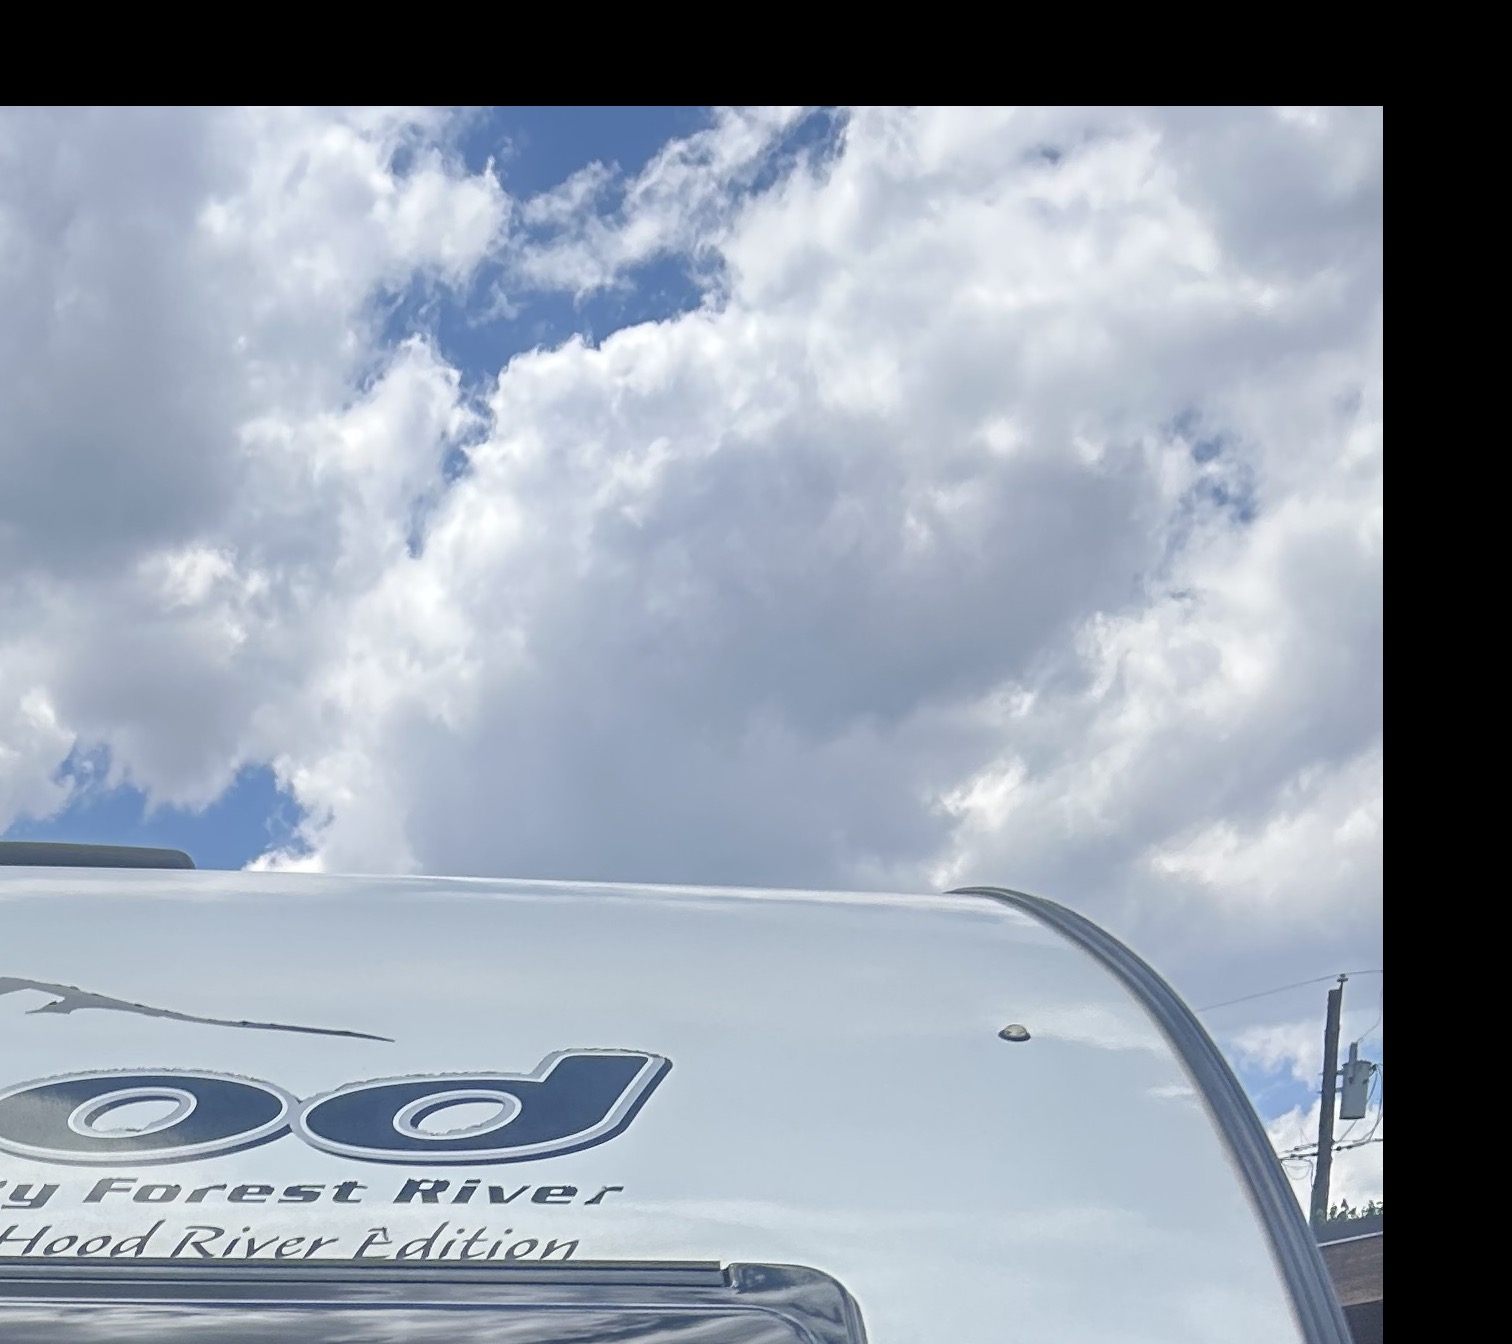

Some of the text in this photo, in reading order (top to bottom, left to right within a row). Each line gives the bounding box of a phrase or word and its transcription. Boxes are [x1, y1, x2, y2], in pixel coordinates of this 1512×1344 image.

[83, 1177, 373, 1206] Forest
[392, 1177, 626, 1206] River
[169, 1226, 339, 1260] River
[351, 1220, 582, 1262] Edition
